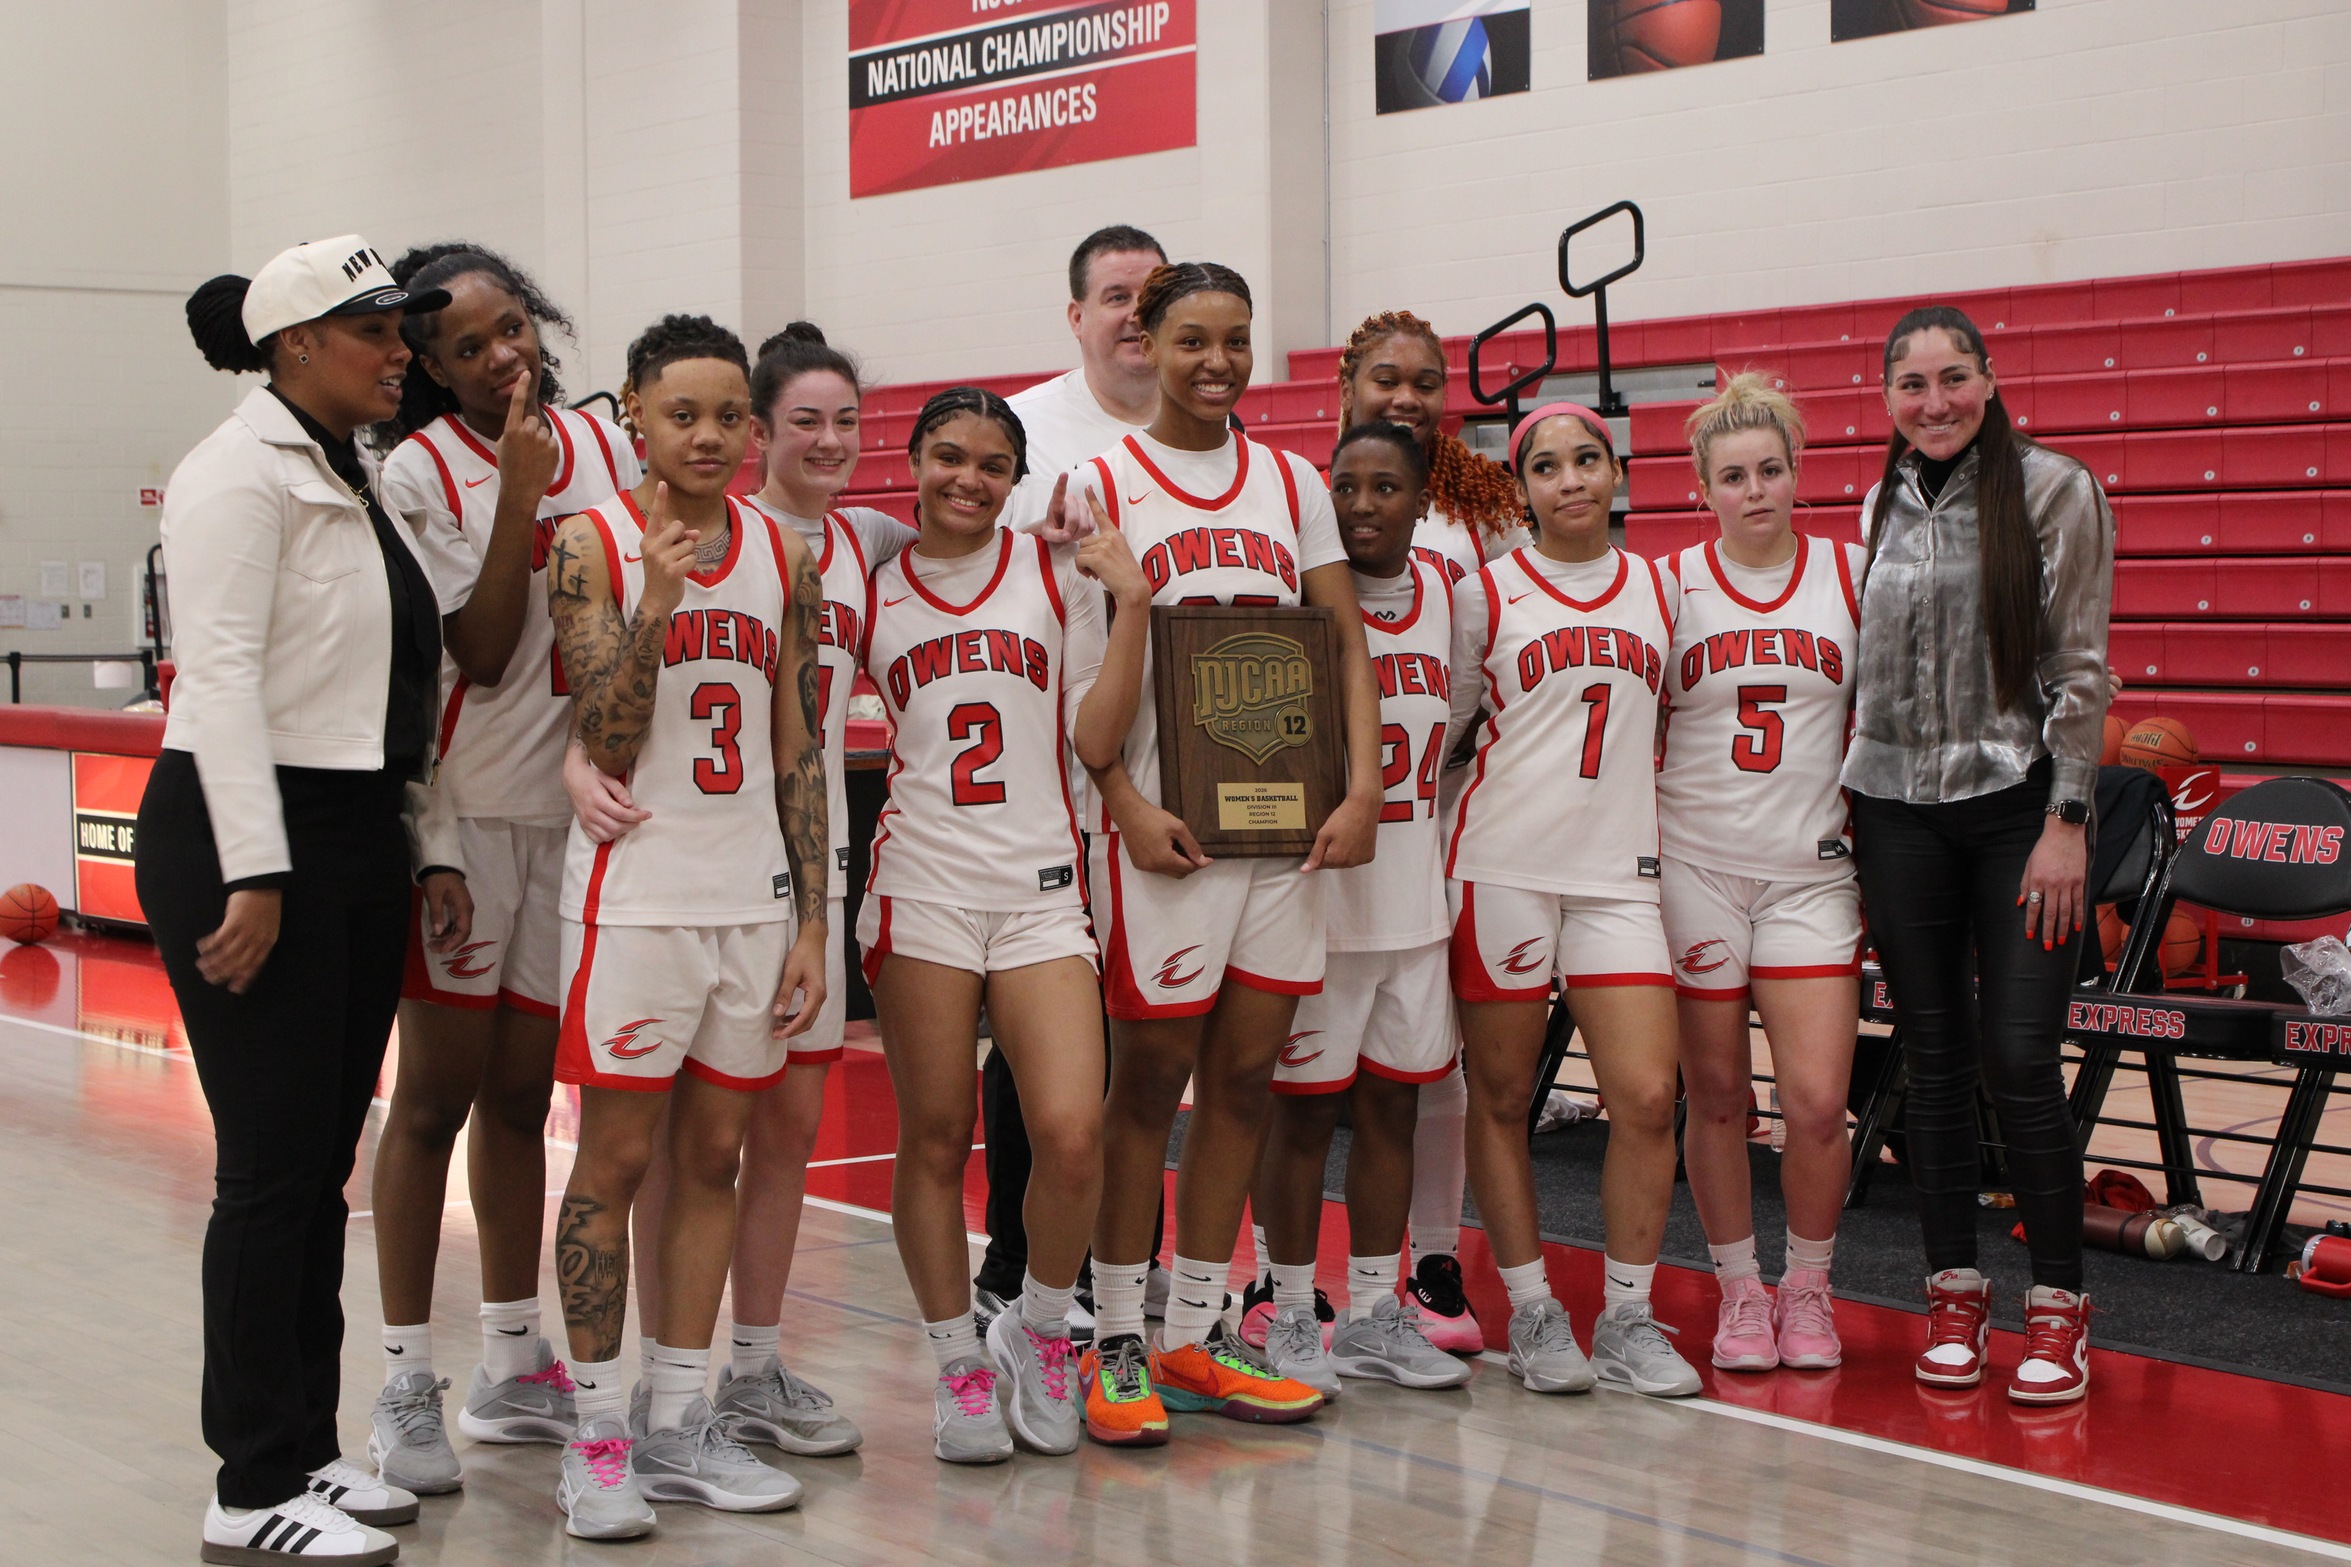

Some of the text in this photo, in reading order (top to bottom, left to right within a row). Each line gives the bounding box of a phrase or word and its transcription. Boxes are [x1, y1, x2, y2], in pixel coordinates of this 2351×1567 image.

[867, 1, 1170, 97] NATIONAL CHAMPIONSHIP
[929, 83, 1097, 148] APPEARANCES
[341, 248, 373, 283] NEW
[1141, 527, 1298, 597] OWENS
[662, 608, 778, 688] WENS
[887, 629, 1049, 712] OWENS
[1371, 652, 1451, 710] WEN
[1517, 626, 1662, 696] OWENS
[1680, 628, 1844, 692] OWENS
[1197, 656, 1307, 716] NJCAA
[690, 682, 744, 795] 3
[947, 701, 1007, 807] 2
[1222, 715, 1307, 735] REGION 12
[1578, 682, 1612, 780] 1
[1731, 684, 1788, 774] 5
[1378, 722, 1447, 824] 24
[80, 821, 134, 853] HOME OF
[2203, 816, 2345, 865] OWENS
[2067, 1001, 2186, 1040] EXPRESS
[2284, 1021, 2351, 1055] EXPR
